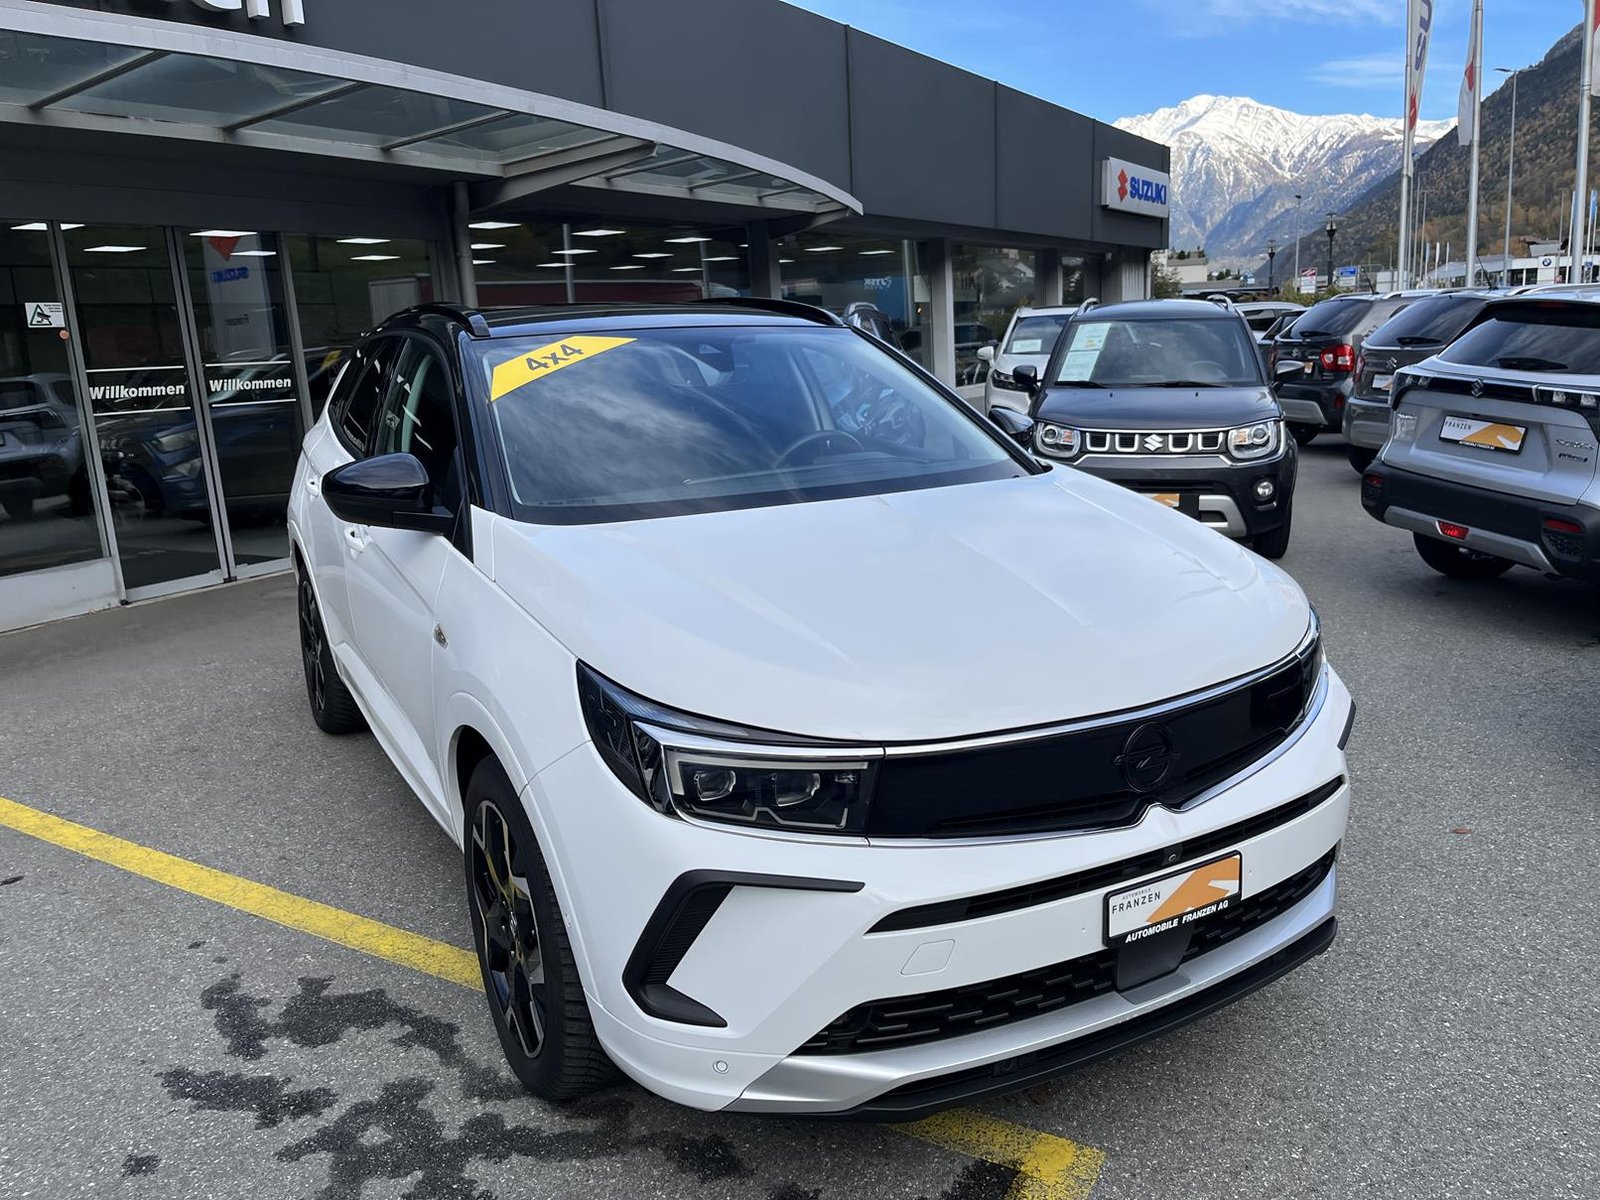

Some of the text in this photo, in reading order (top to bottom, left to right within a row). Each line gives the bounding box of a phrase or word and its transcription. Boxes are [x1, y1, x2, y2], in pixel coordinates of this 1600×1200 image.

[1130, 176, 1167, 205] SUZUKI
[526, 344, 584, 371] 4x4
[89, 384, 185, 399] Willkommen
[209, 378, 291, 392] Willkommen
[1445, 420, 1472, 431] FRANZEN
[1112, 891, 1161, 914] FRANZEN
[1122, 888, 1151, 900] AUTOMOBILE
[1125, 900, 1229, 943] AUTOMOBILE FRANZEN AG
